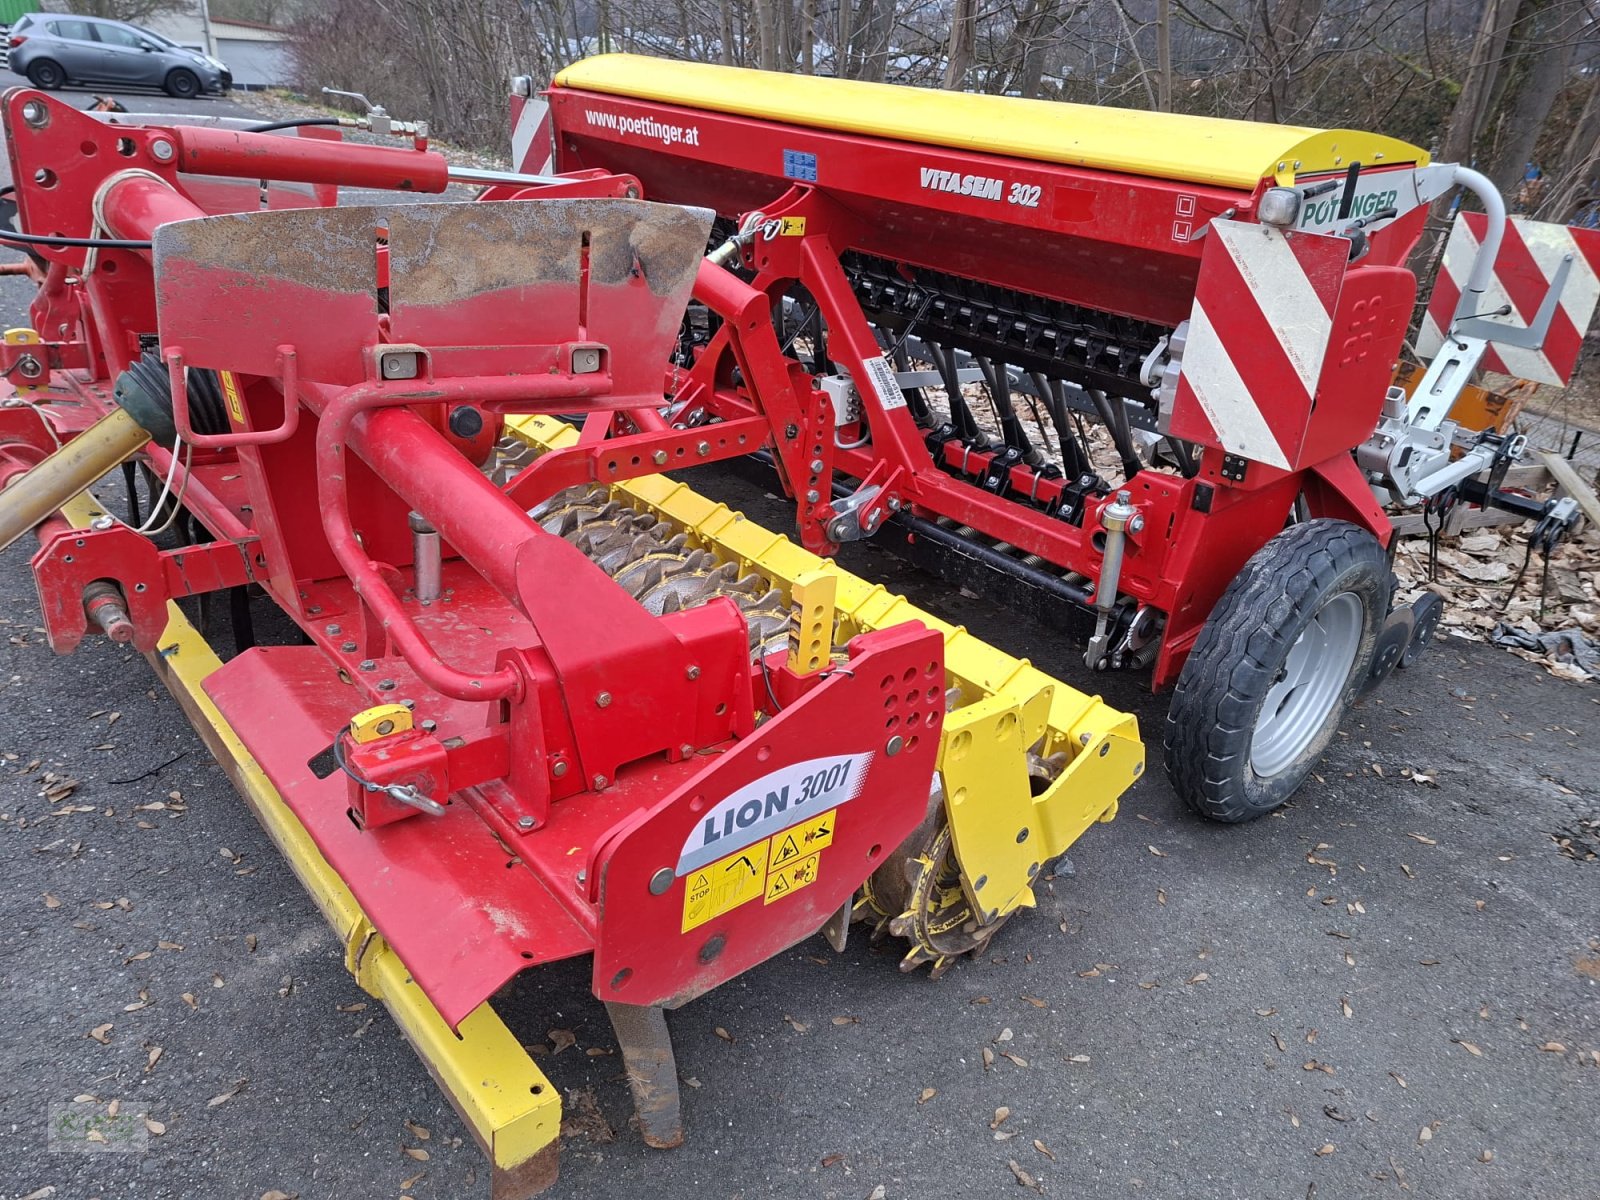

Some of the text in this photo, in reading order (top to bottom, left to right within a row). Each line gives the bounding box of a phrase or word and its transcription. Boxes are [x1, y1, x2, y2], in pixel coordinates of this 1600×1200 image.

[585, 109, 699, 146] www.poettinger.at
[920, 167, 1042, 208] VITASEM 302
[703, 758, 853, 846] LION 3001
[689, 887, 710, 902] STOP
